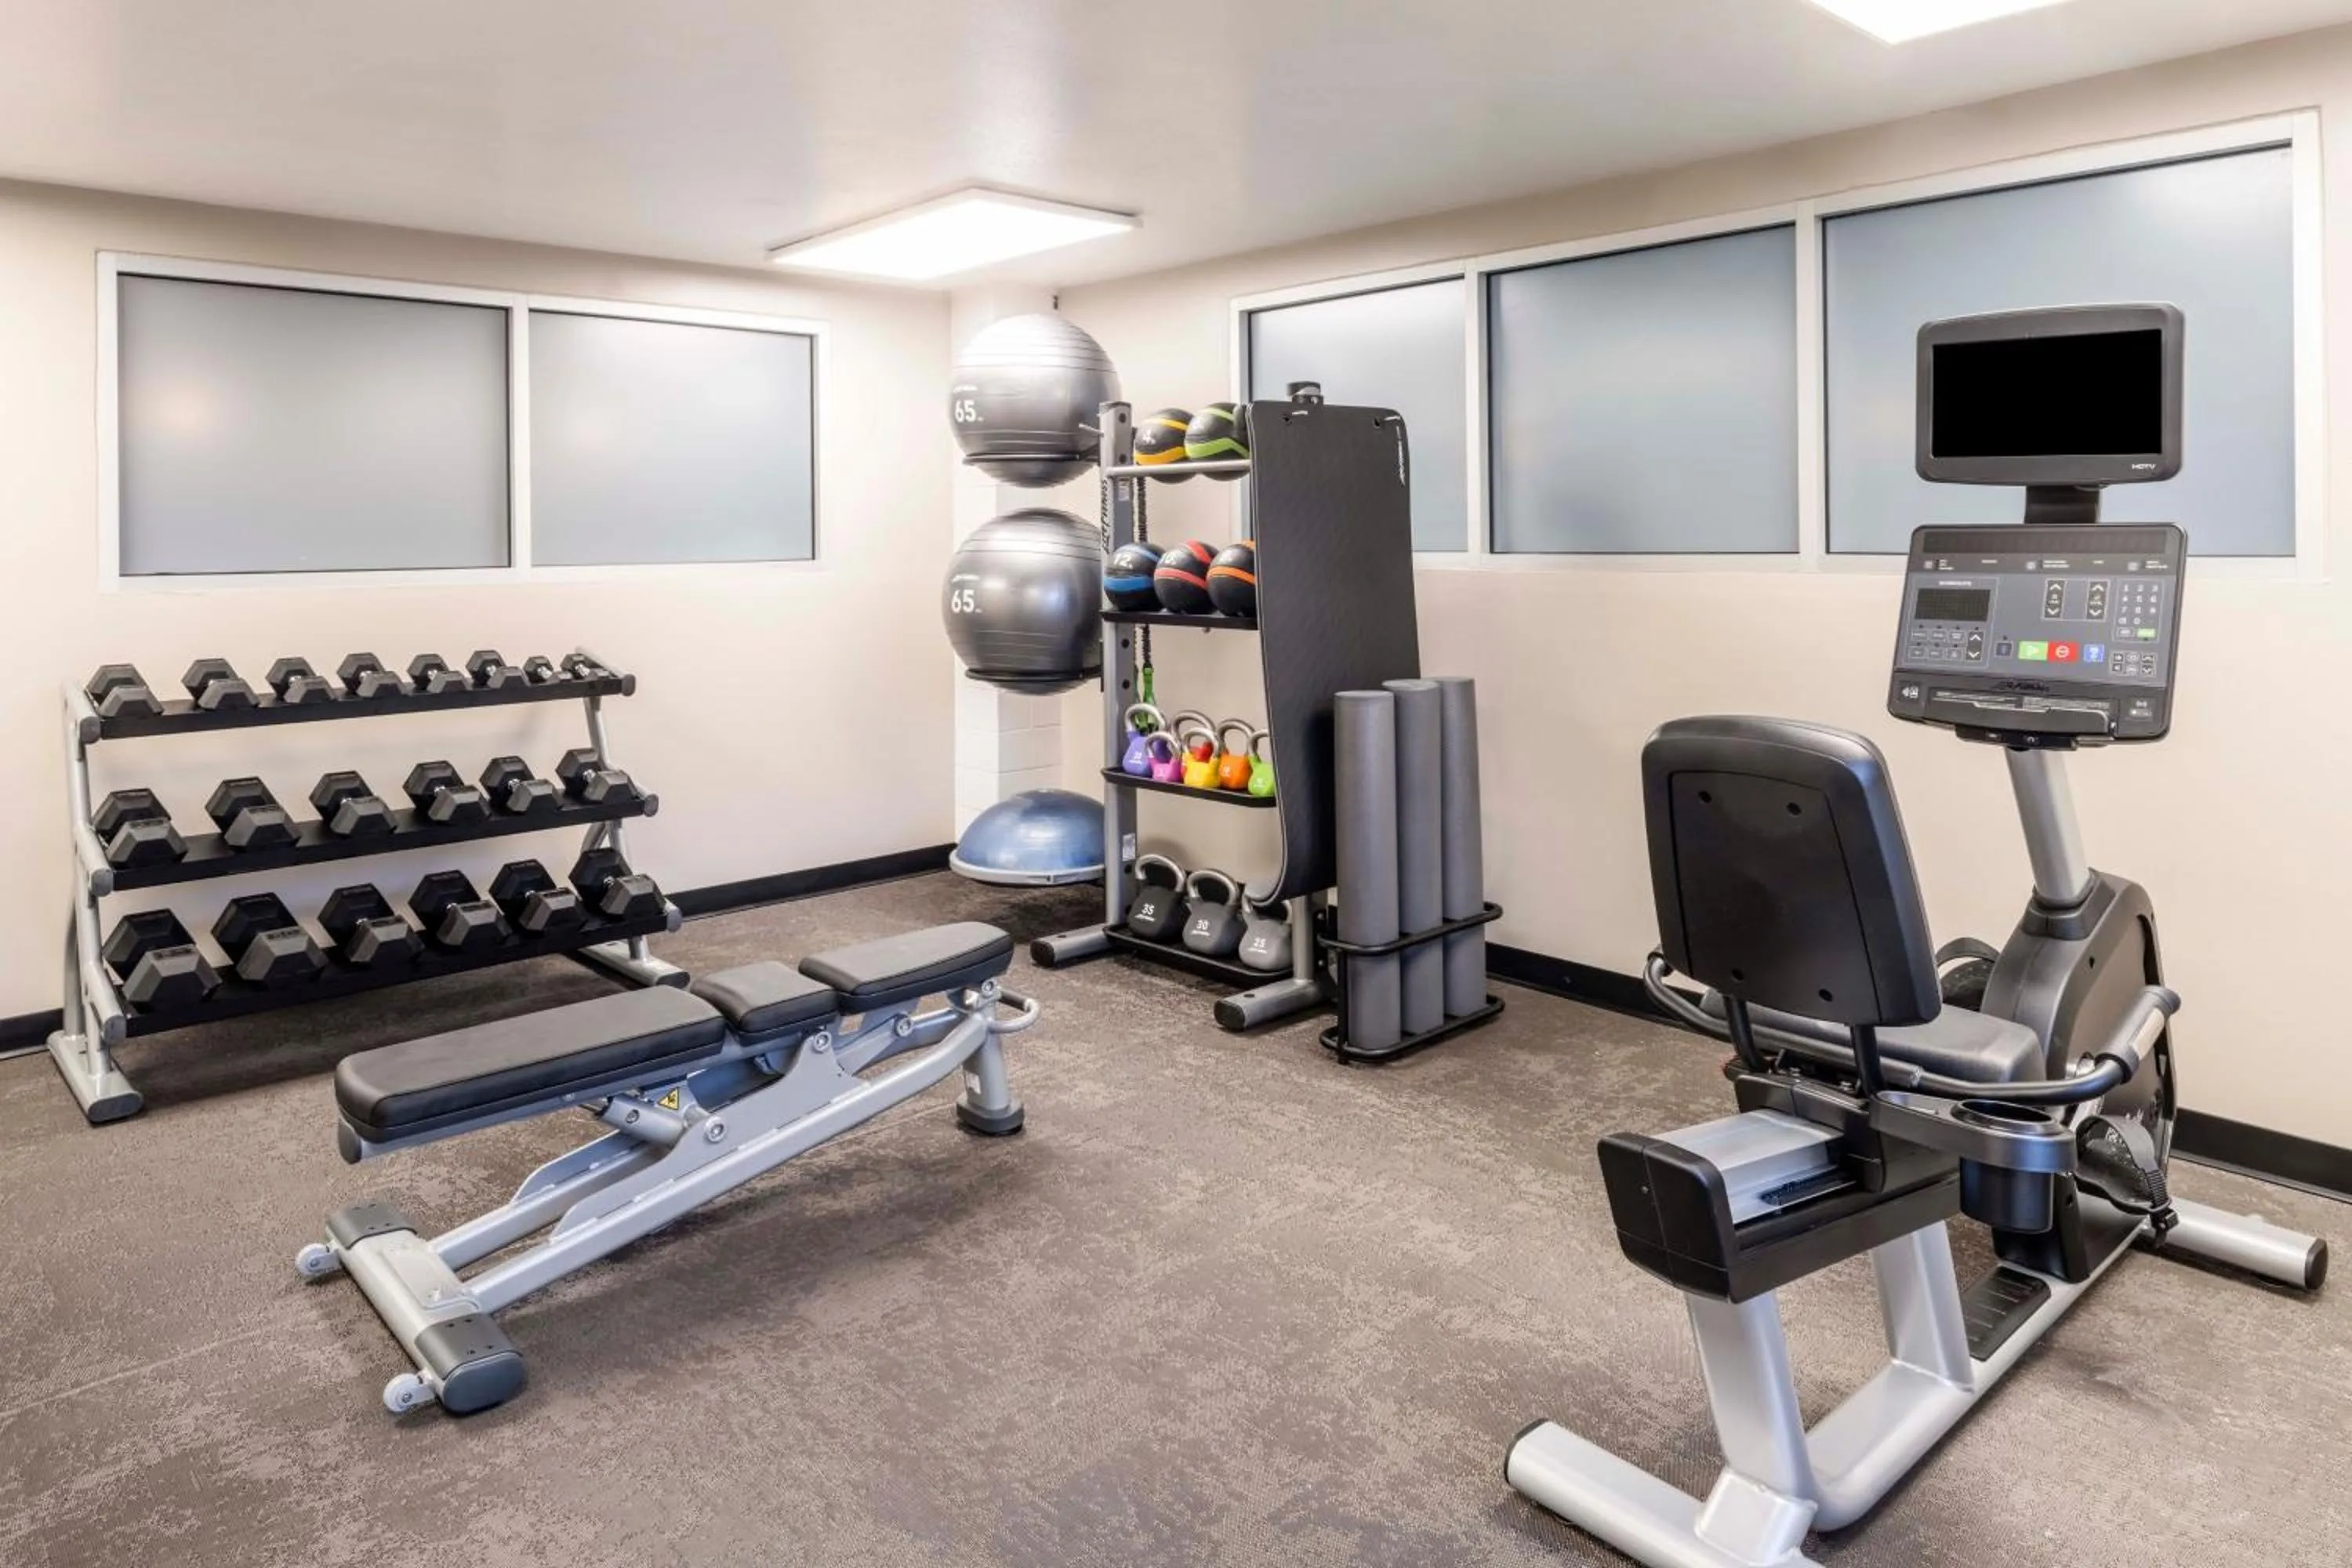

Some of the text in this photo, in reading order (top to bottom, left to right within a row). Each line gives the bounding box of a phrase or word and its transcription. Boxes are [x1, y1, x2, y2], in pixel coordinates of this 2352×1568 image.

[955, 400, 976, 423] 65
[1114, 554, 1131, 568] 12
[952, 589, 975, 612] 65
[1142, 903, 1155, 915] 35
[1196, 920, 1209, 931] 30
[1254, 938, 1267, 948] 25
